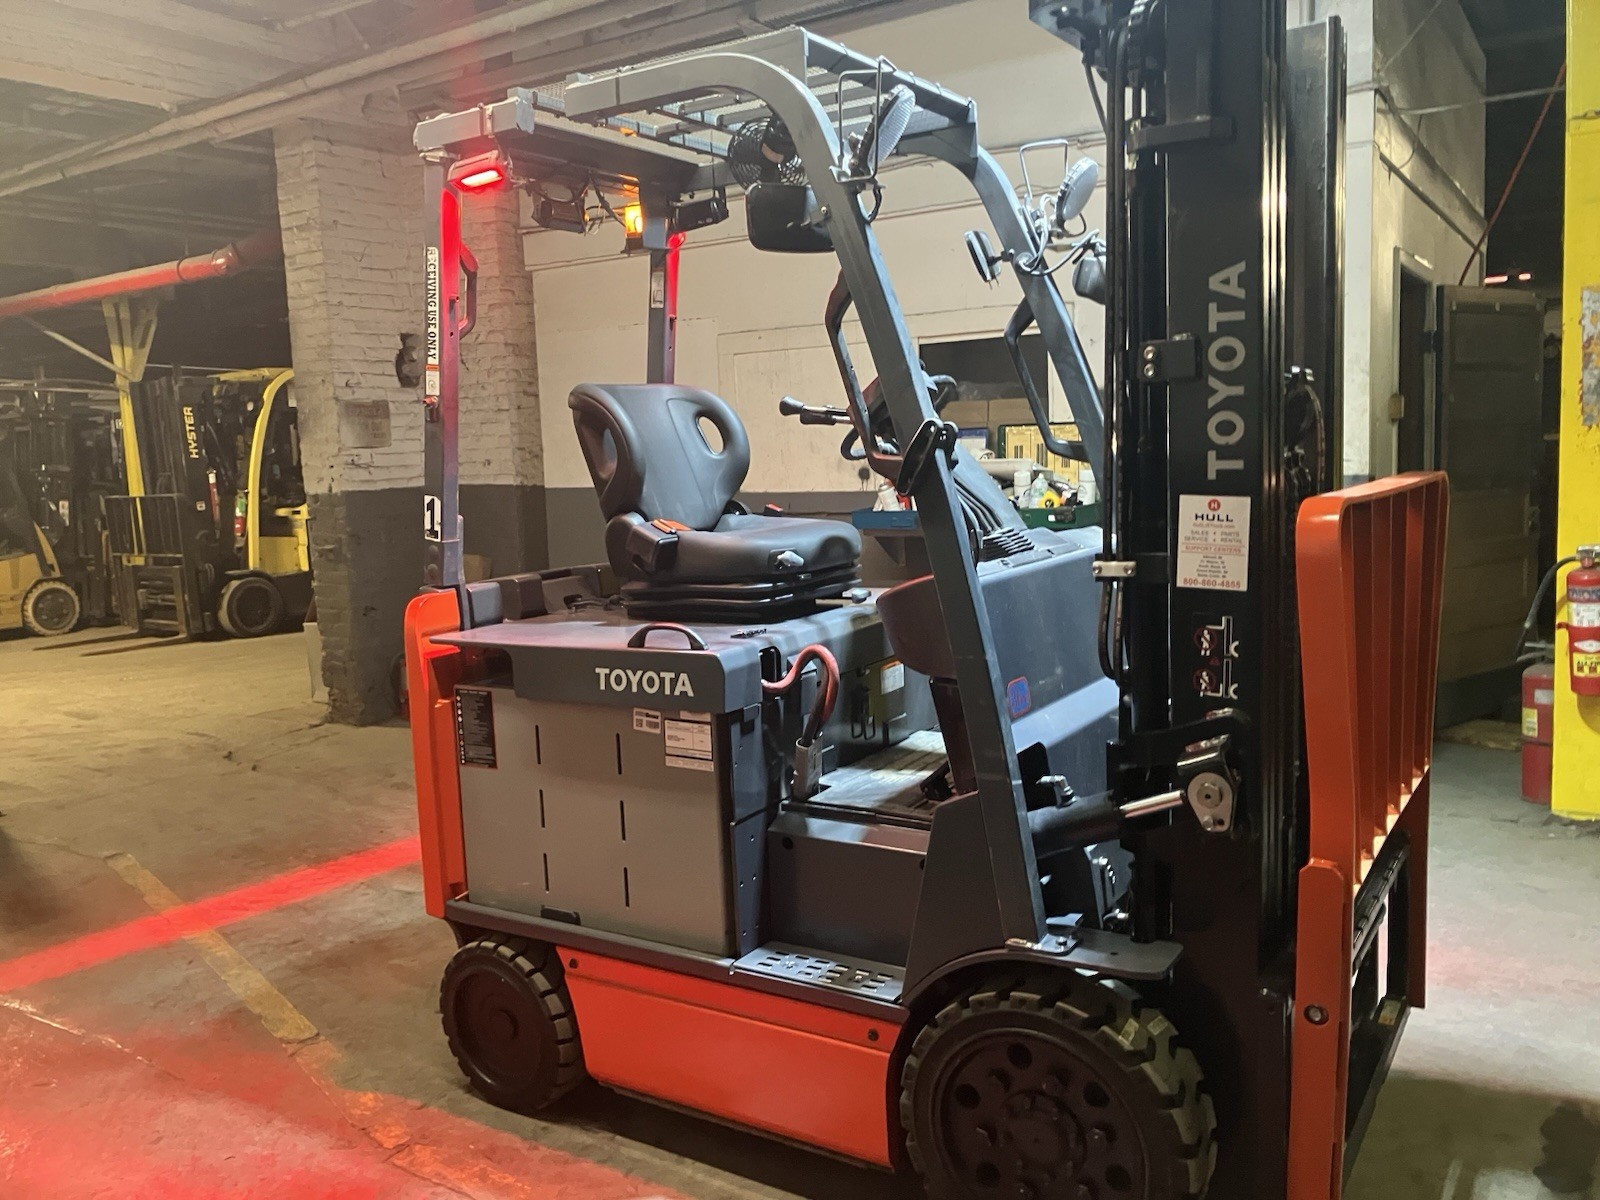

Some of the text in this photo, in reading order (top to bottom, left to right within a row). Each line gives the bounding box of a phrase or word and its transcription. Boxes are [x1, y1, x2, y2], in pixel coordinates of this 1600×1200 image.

[427, 248, 437, 307] RECEIVING
[427, 310, 437, 329] USE
[427, 331, 437, 360] ONLY
[1206, 260, 1247, 480] TOYOTA
[183, 406, 199, 459] HYSTER
[1195, 513, 1234, 522] HULL
[595, 667, 695, 697] TOYOTA
